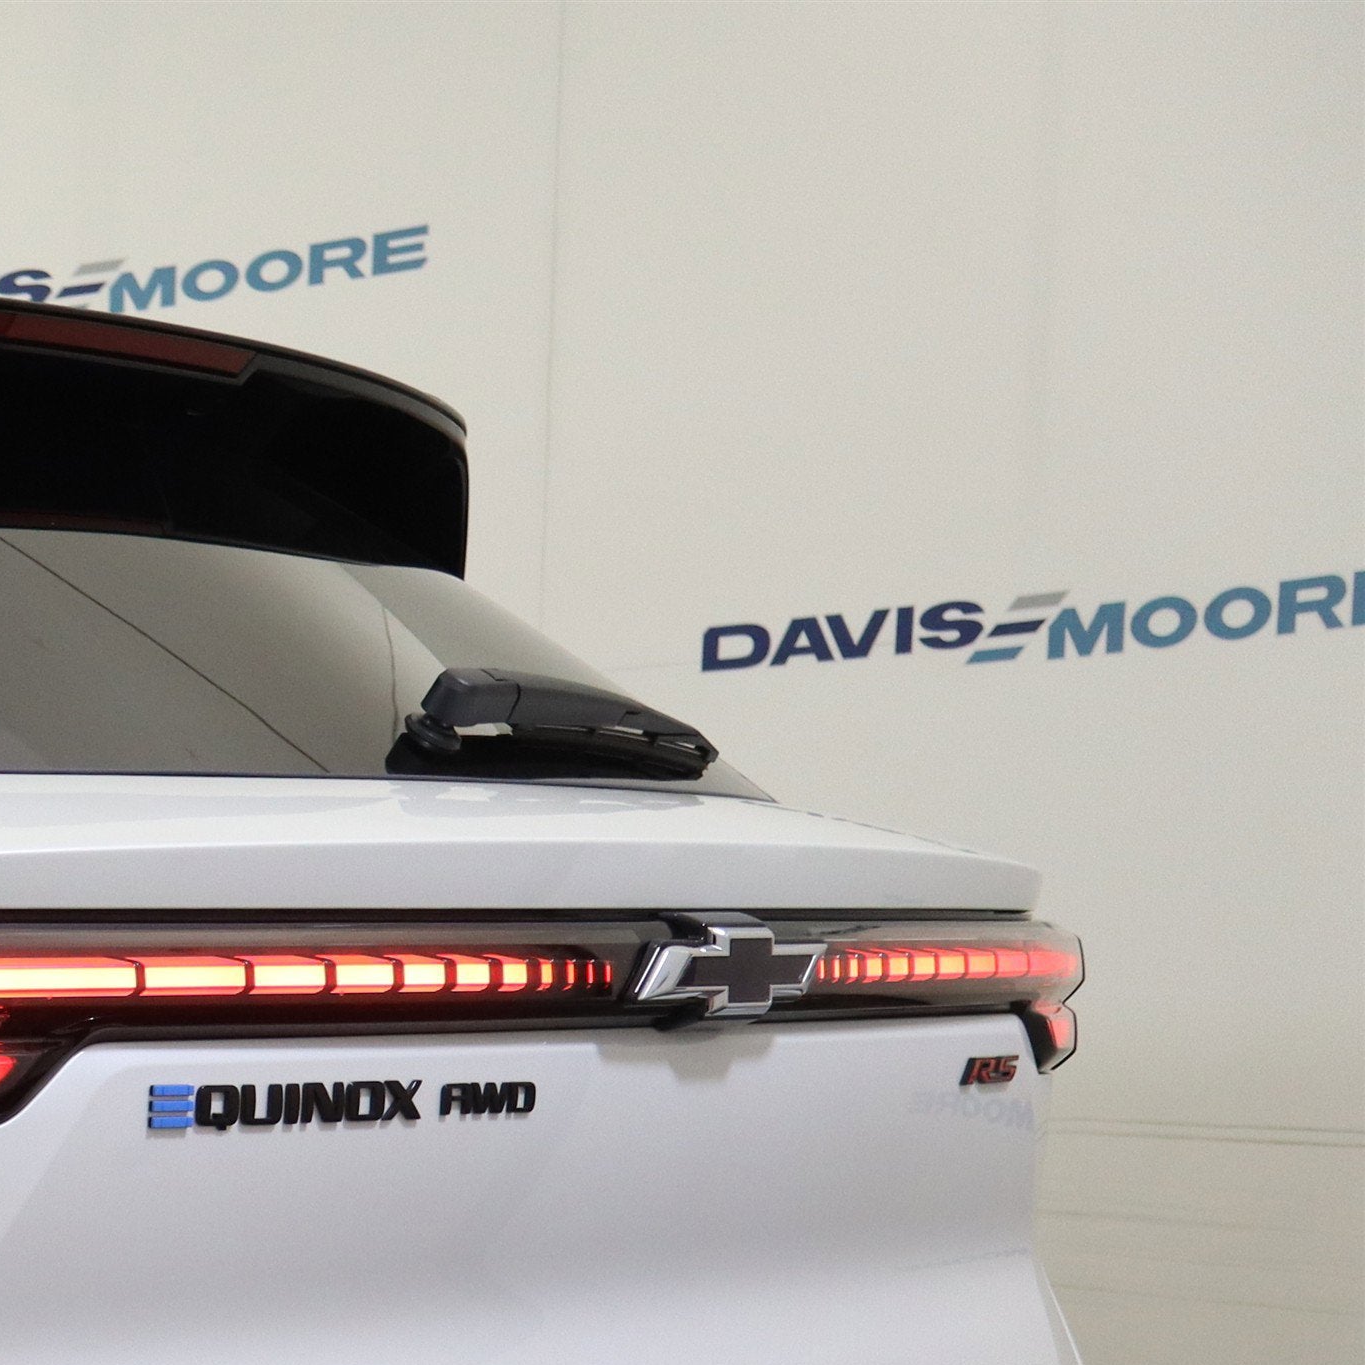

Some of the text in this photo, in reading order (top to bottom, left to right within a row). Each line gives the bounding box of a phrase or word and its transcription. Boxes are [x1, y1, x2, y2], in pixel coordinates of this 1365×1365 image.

[109, 225, 429, 314] MOORE
[701, 570, 1365, 672] DAVIS MOOR
[148, 1080, 537, 1131] EQUINOX AWD
[959, 1055, 1019, 1086] RS
